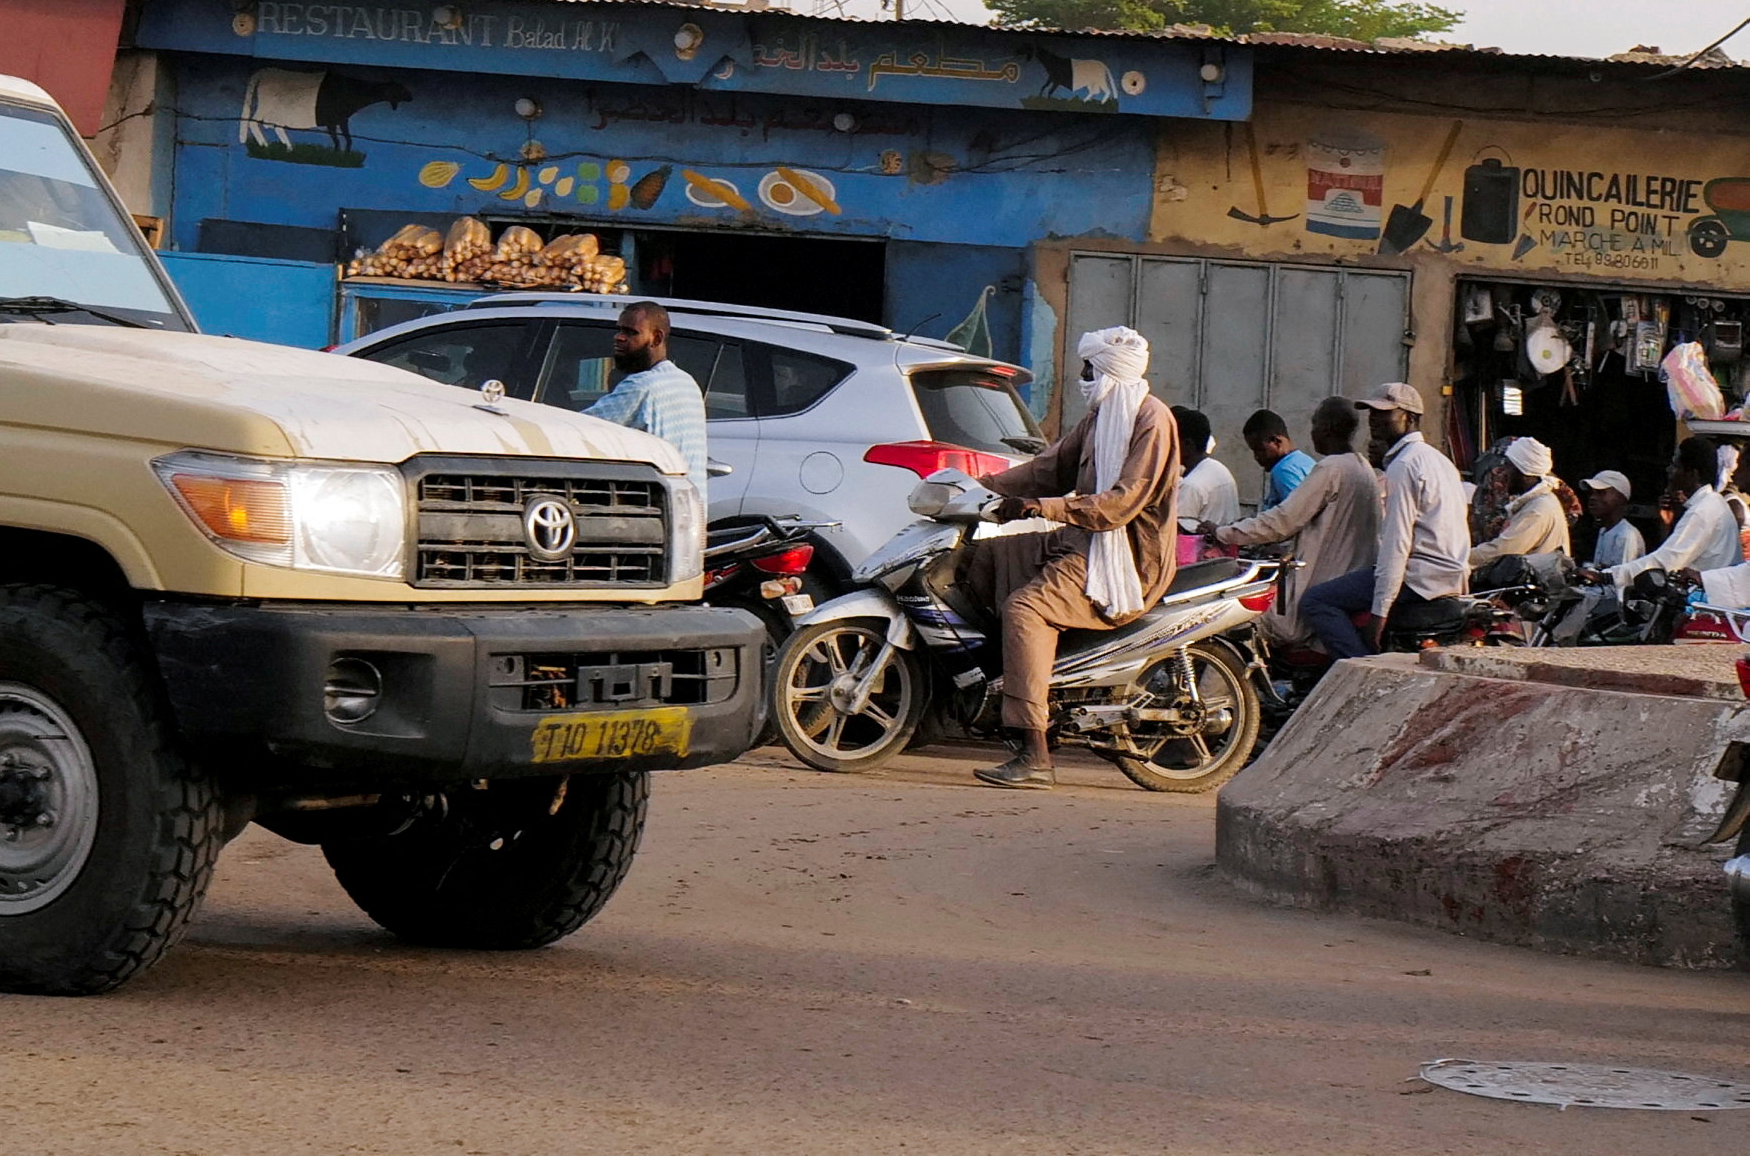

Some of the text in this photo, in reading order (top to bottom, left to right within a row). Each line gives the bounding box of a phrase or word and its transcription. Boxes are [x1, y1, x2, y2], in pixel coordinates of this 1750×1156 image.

[257, 1, 498, 47] RESTAURANT
[503, 15, 566, 49] Balad
[815, 38, 860, 81] بلد
[867, 40, 1020, 93] مطعم
[1522, 168, 1703, 214] QUINCAILERIE
[1538, 202, 1680, 237] ROND POINT
[1539, 229, 1623, 253] MARCHE
[1630, 235, 1648, 256] A
[595, 719, 658, 756] 11378
